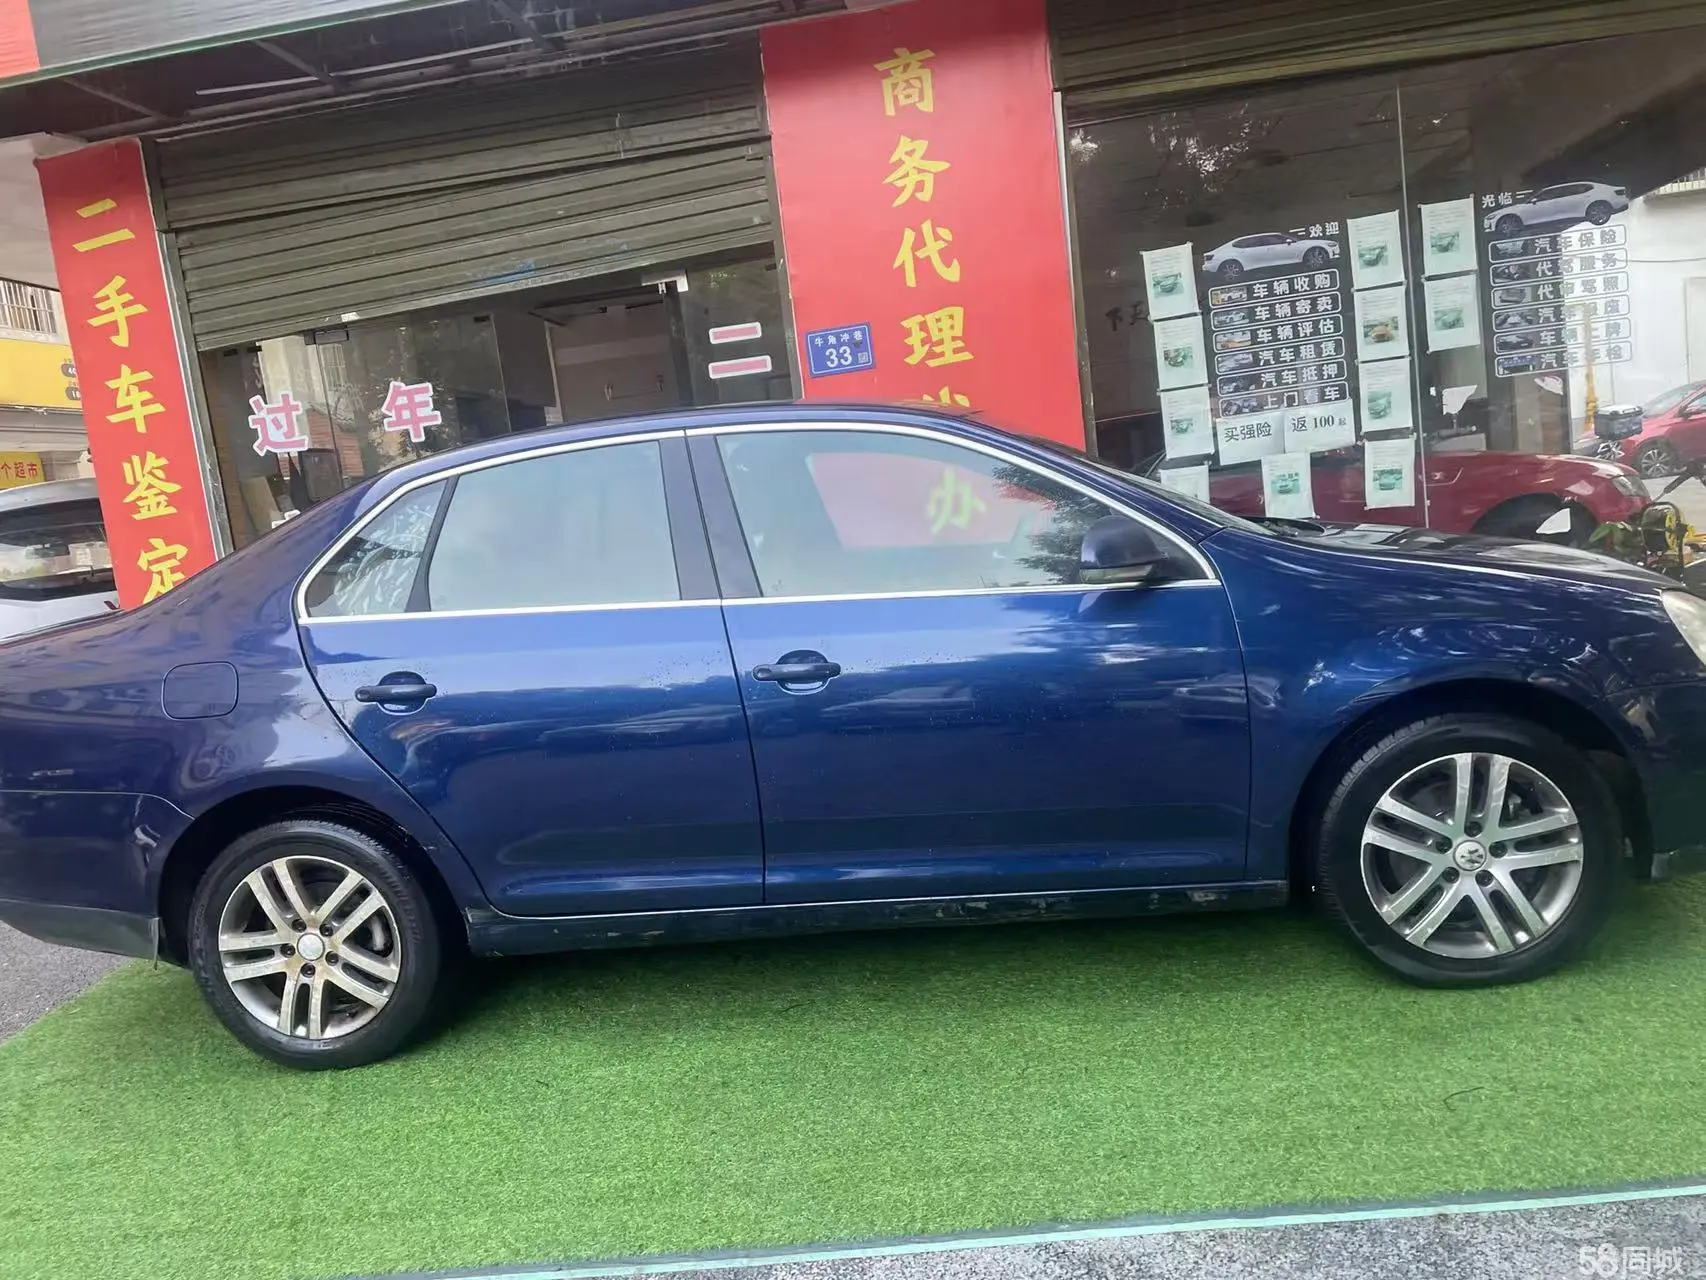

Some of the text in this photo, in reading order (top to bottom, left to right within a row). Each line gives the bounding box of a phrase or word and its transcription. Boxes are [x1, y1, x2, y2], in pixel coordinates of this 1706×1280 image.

[1309, 222, 1339, 238] 欢迎
[1535, 228, 1617, 254] 汽车保险
[1253, 273, 1331, 298] 车辆收购
[1255, 296, 1333, 320] 车辆寄卖
[1257, 318, 1334, 343] 车辆评估
[825, 345, 853, 368] 33
[1259, 340, 1336, 366] 汽车租赁
[1260, 363, 1338, 388] 汽车抵押
[72, 198, 188, 604] 二手车鉴定
[1263, 386, 1340, 410] 上门看车
[1224, 421, 1272, 443] 买强险
